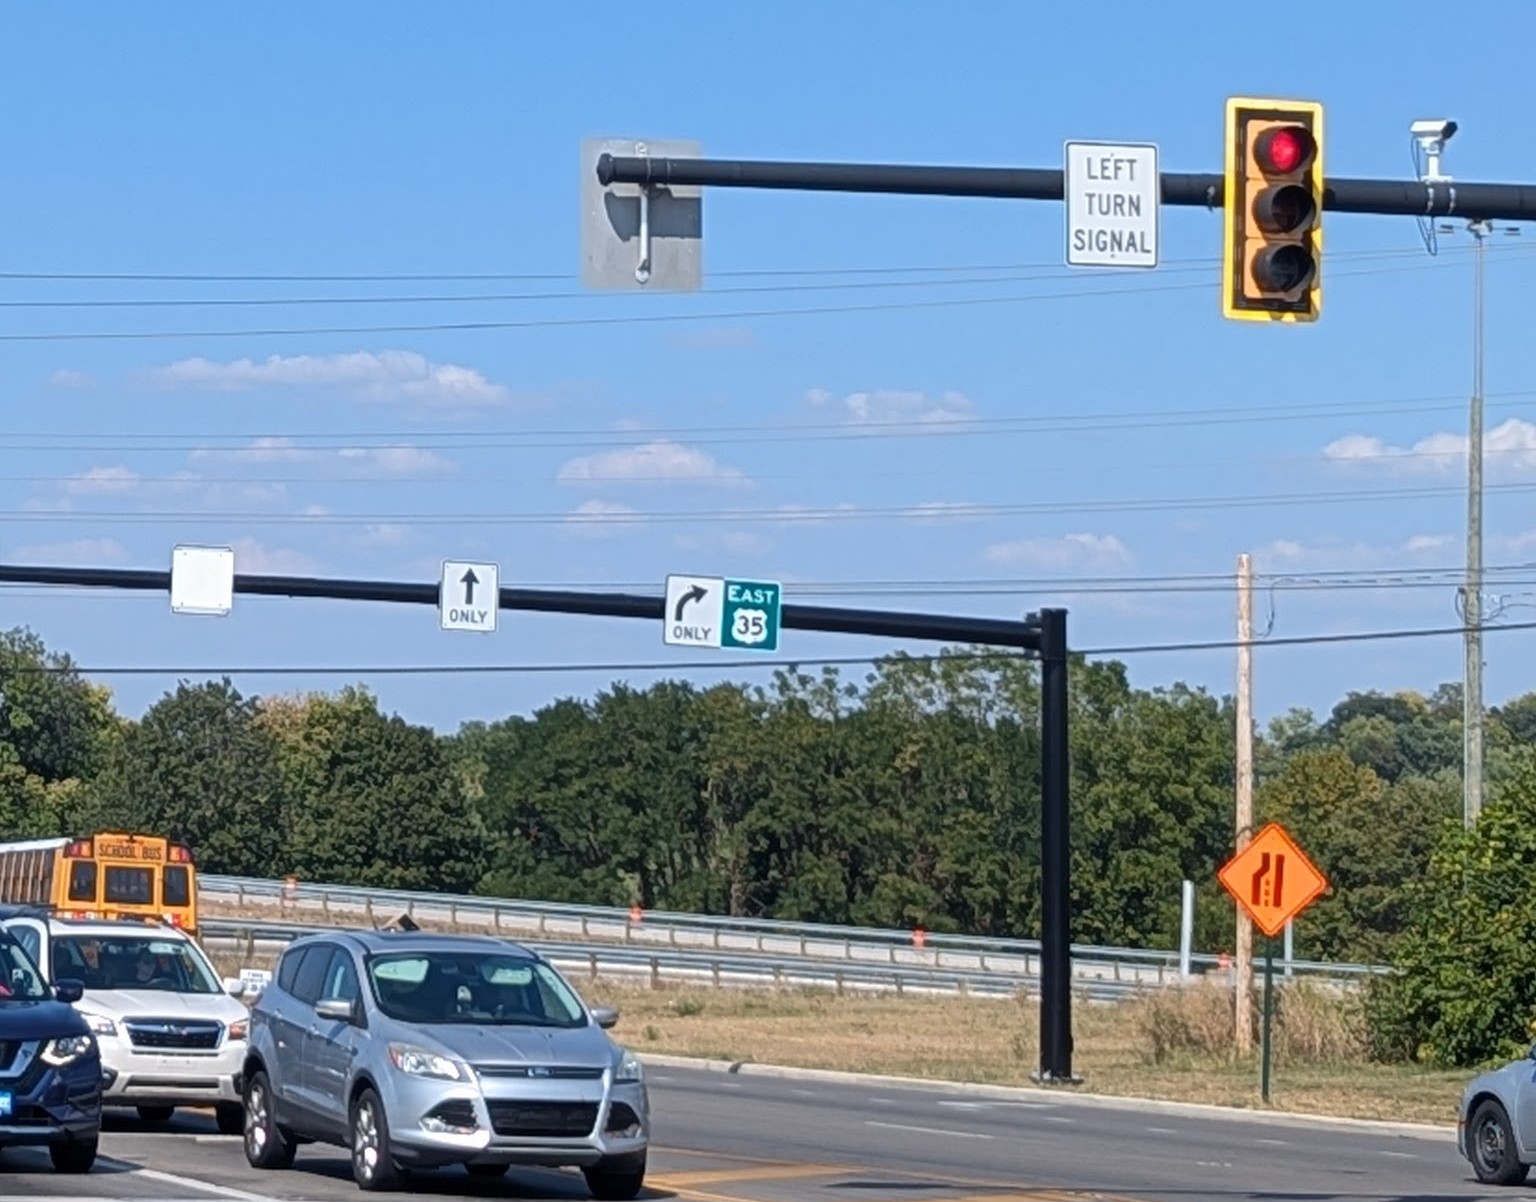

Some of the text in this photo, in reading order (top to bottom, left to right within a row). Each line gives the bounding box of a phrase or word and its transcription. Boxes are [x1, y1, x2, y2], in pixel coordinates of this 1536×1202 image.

[1086, 156, 1138, 181] LEFT
[1084, 192, 1142, 217] TURN
[1073, 228, 1153, 254] SIGNAL
[727, 584, 775, 605] EAST
[449, 608, 488, 624] ONLY
[736, 615, 763, 636] 35
[672, 625, 712, 641] ONLY
[99, 843, 162, 860] SCHOOL BUS
